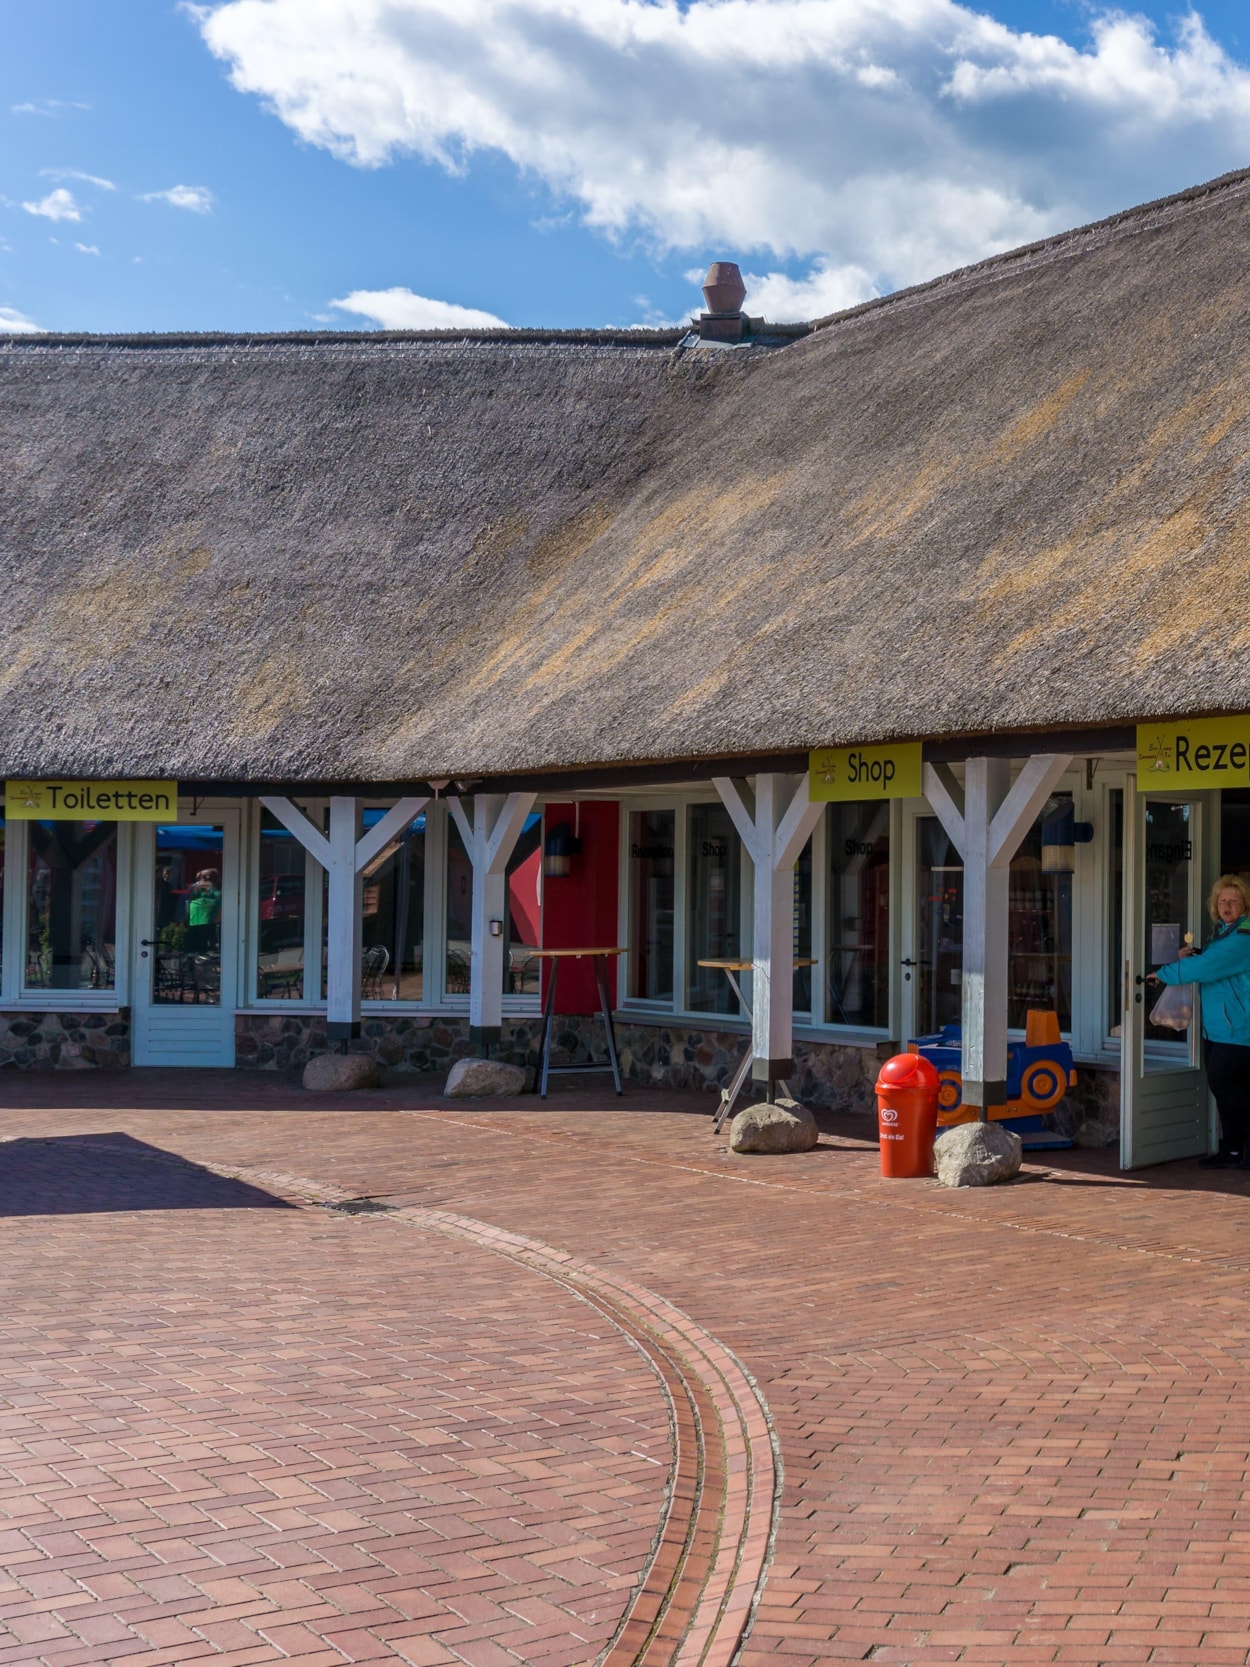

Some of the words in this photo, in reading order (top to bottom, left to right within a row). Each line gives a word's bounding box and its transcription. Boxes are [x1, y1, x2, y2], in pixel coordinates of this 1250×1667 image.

[847, 752, 896, 790] Shop
[46, 786, 169, 810] Toiletten
[702, 842, 726, 859] Shop
[845, 839, 874, 858] Shop
